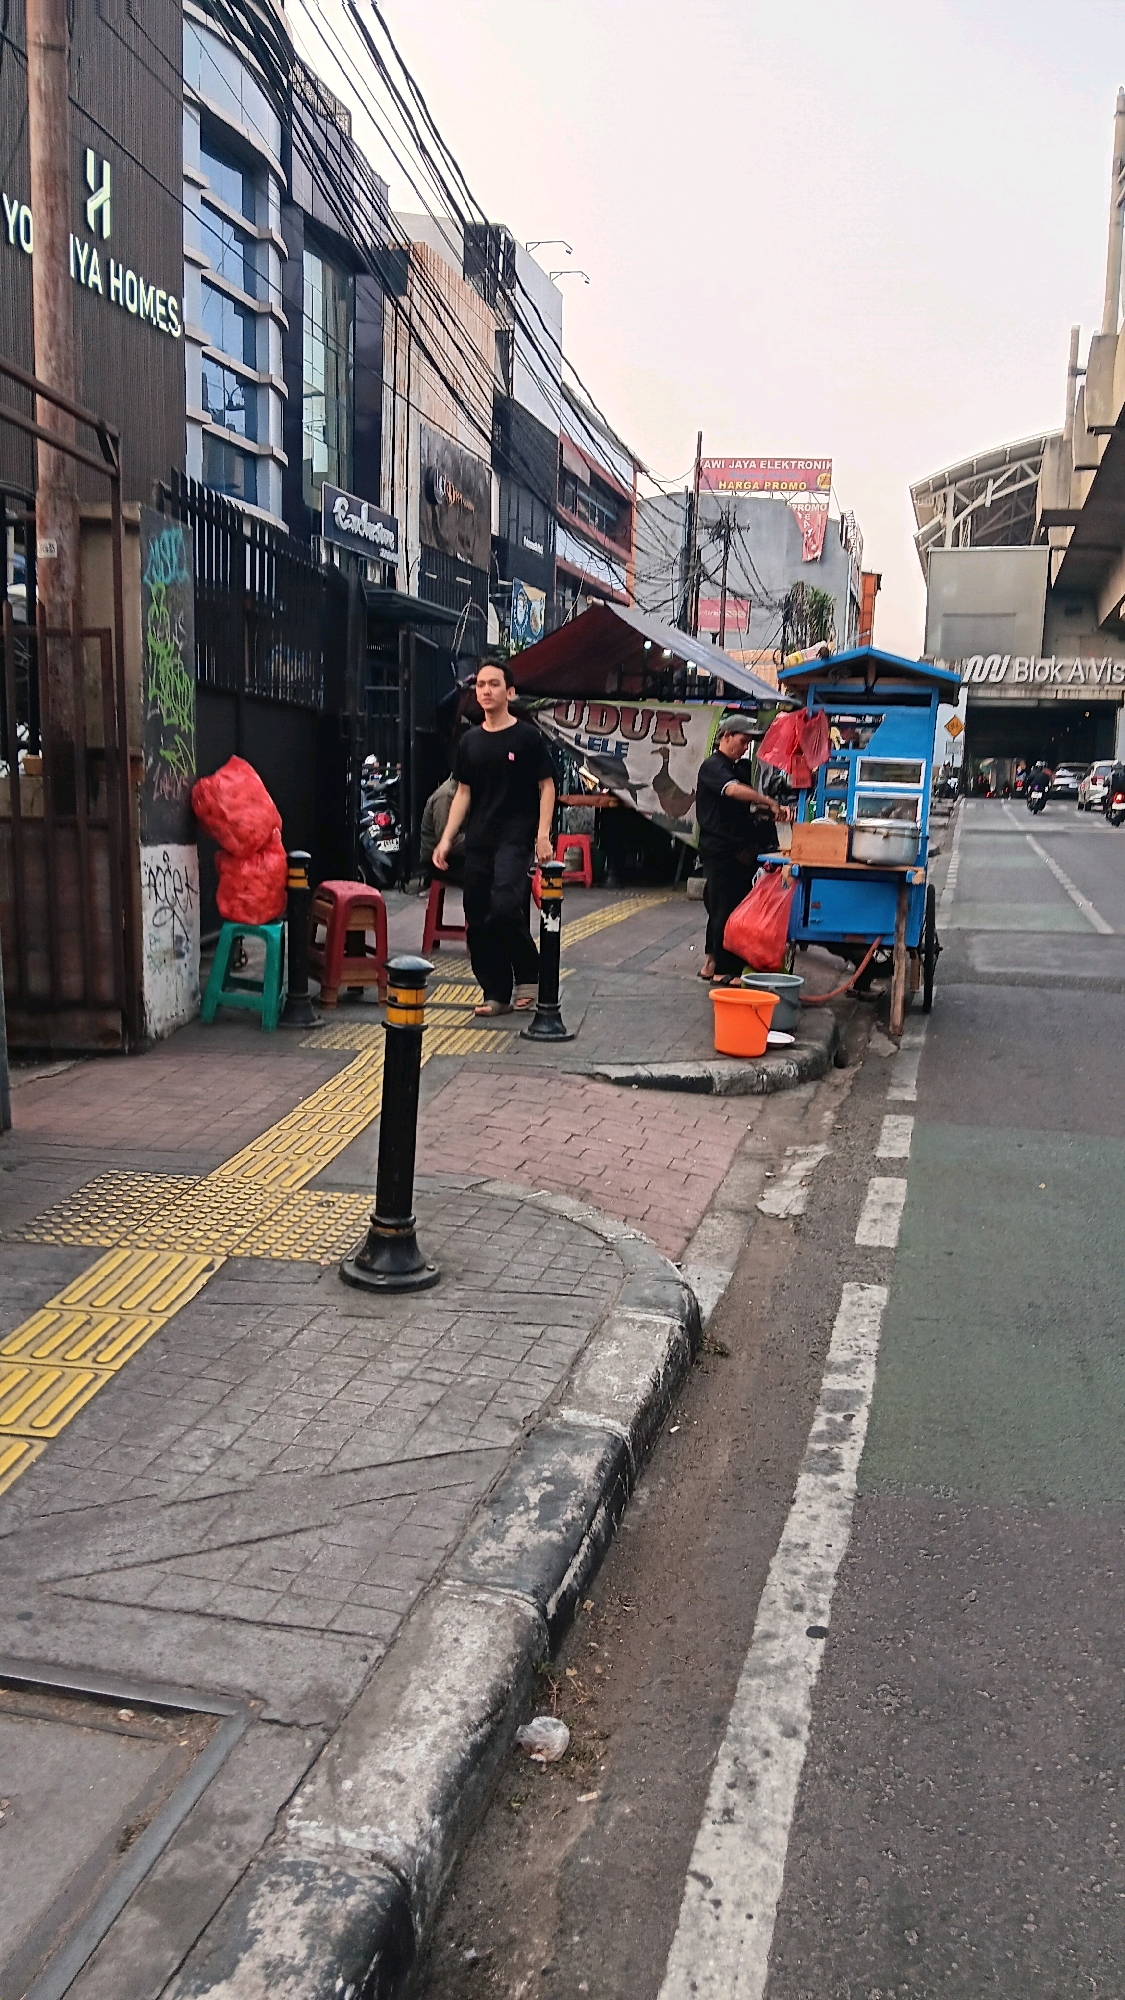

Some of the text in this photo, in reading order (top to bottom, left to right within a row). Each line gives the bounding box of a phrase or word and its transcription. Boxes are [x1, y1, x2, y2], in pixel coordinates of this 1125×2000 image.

[110, 257, 181, 338] HOMES
[729, 460, 757, 469] JAYA
[718, 481, 807, 490] HARGA PROMO
[1015, 655, 1063, 683] Blok
[553, 700, 692, 747] UDUK
